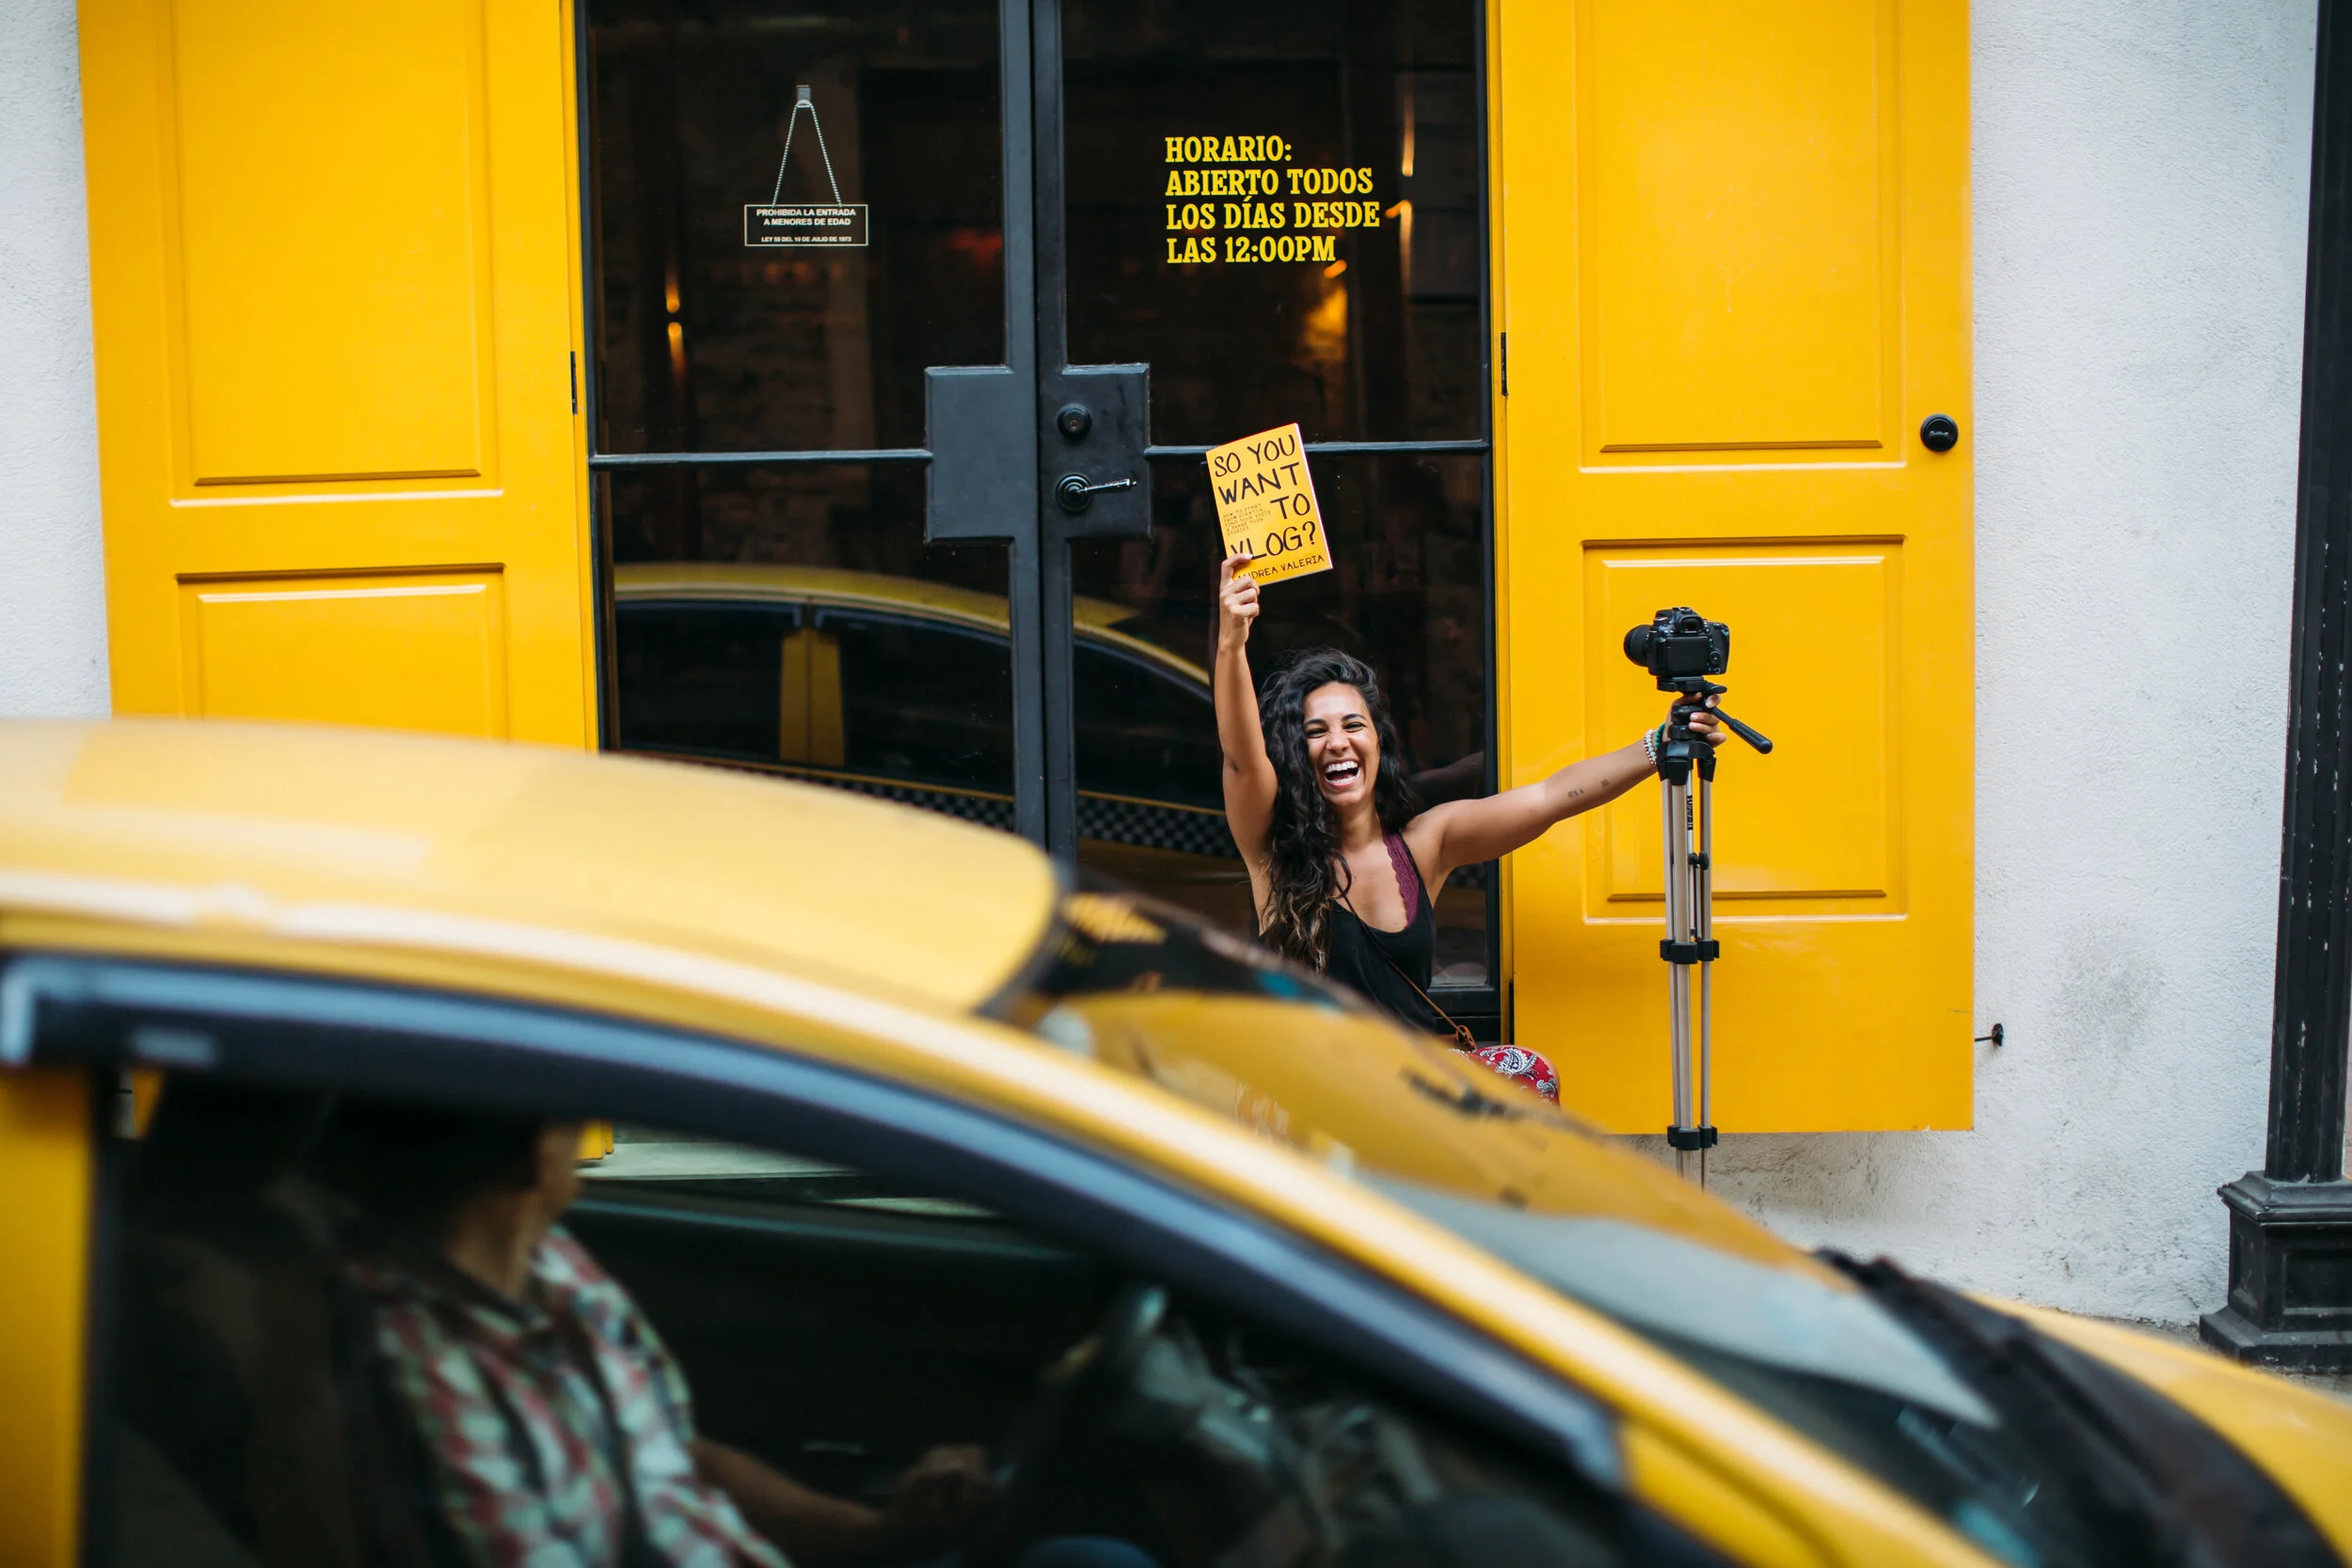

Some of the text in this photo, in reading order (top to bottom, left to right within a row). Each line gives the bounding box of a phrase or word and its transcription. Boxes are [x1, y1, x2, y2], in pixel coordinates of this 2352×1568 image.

[1165, 135, 1292, 163] HORARIO:
[1165, 167, 1374, 196] ABIERTO TODOS
[763, 217, 851, 226] A MENORES DE EDAD
[1166, 195, 1380, 230] LOS DÍAS DESDE
[1167, 235, 1336, 263] LAS 12:00PM
[1214, 434, 1295, 478] SO YOU
[1217, 461, 1300, 505] WANT
[1269, 493, 1311, 520] TO
[1230, 520, 1316, 560] VLOG?
[1280, 555, 1325, 572] VALERIA
